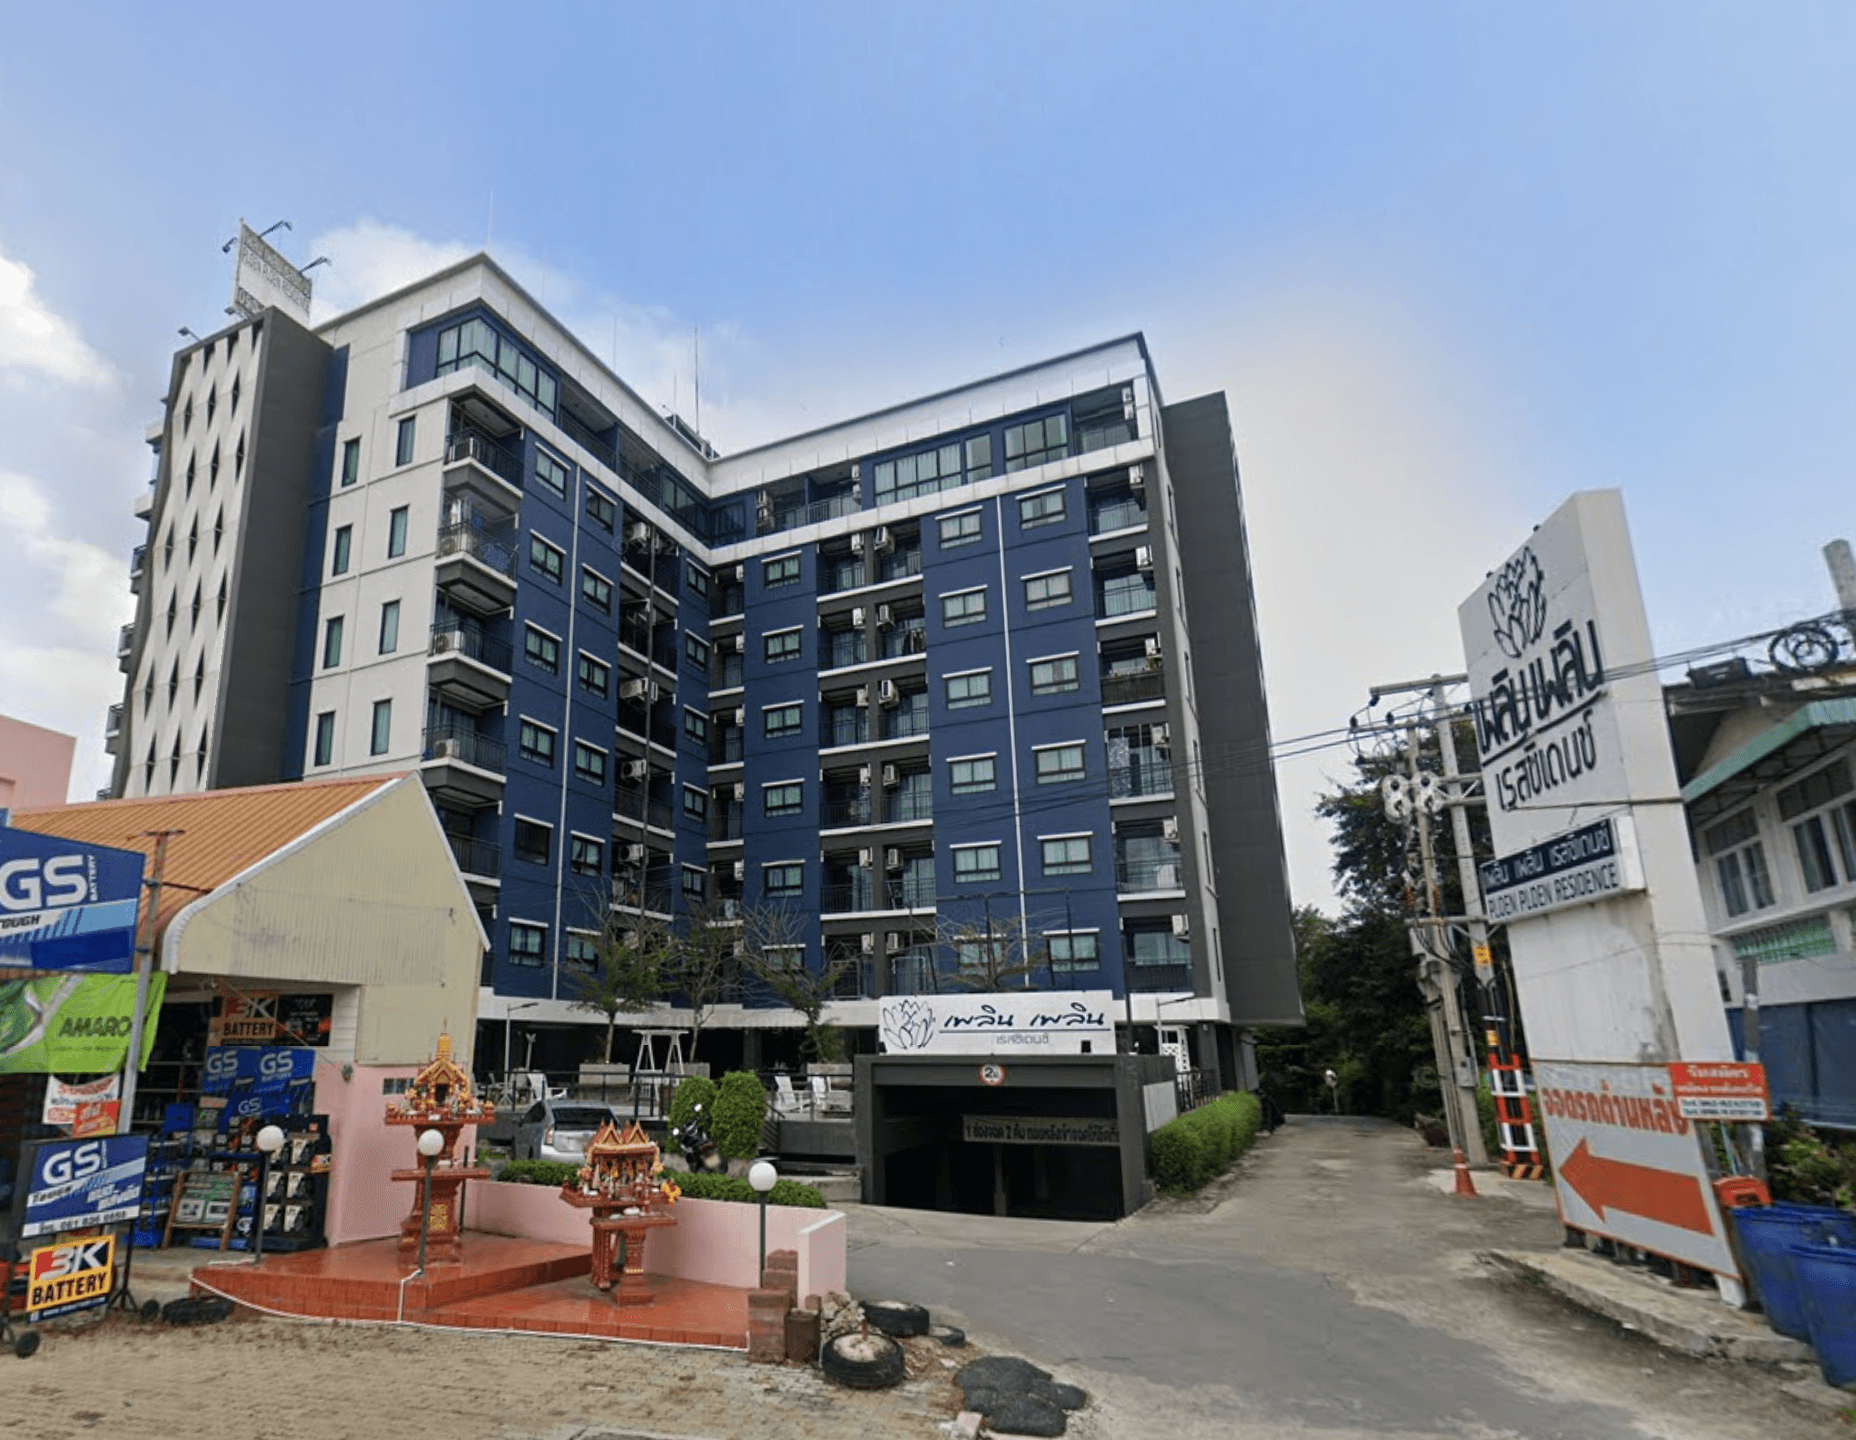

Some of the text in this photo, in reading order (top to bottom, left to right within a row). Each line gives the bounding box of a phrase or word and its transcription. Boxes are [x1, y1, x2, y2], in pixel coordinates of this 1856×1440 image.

[0, 853, 88, 911] GS
[1554, 862, 1619, 901] RESIDENCE
[943, 1002, 1105, 1028] เพลิน เพลิน
[223, 1021, 275, 1036] BATTERY
[207, 1050, 239, 1074] GS
[260, 1050, 294, 1075] GS
[238, 1097, 262, 1115] GS
[43, 1141, 101, 1185] GS
[32, 1272, 107, 1305] BATTERY
